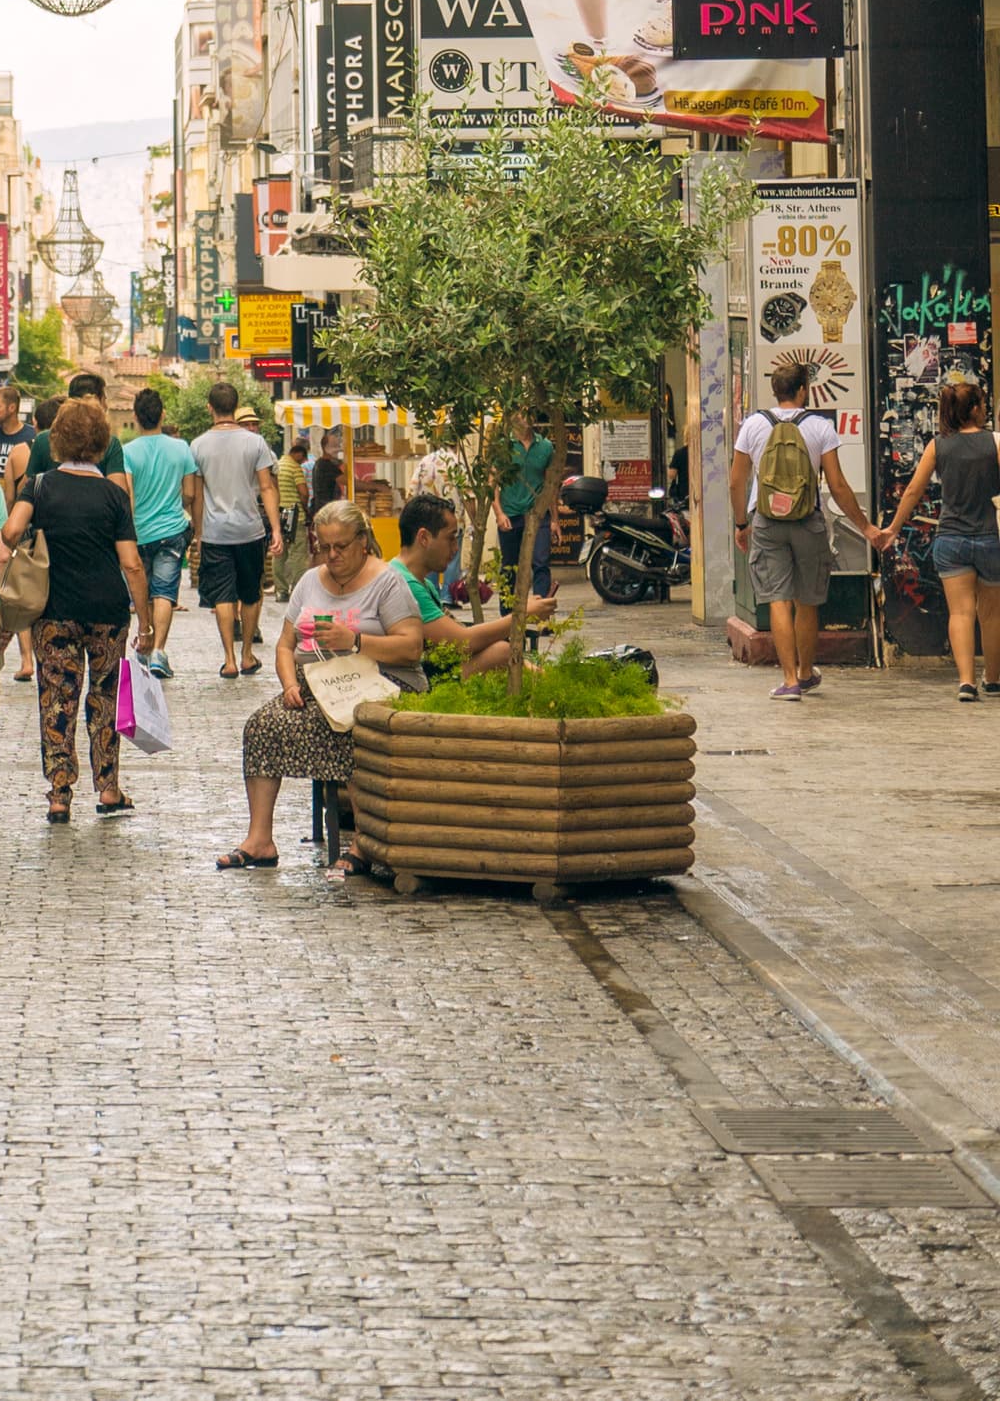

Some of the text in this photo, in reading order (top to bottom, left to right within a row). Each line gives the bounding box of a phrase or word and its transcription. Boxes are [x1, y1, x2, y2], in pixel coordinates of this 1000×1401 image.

[713, 26, 818, 35] woman
[479, 61, 552, 94] UT
[344, 35, 364, 140] PHORA
[753, 97, 779, 111] Café
[781, 99, 809, 111] 10m.
[755, 185, 855, 197] www.watchoutlet24.com
[808, 203, 841, 213] Athens
[762, 224, 852, 257] -80%
[769, 257, 793, 266] New
[759, 265, 810, 275] Genuine
[164, 260, 175, 308] adidas
[760, 280, 804, 290] Brands
[303, 386, 340, 396] ZIC ZAC
